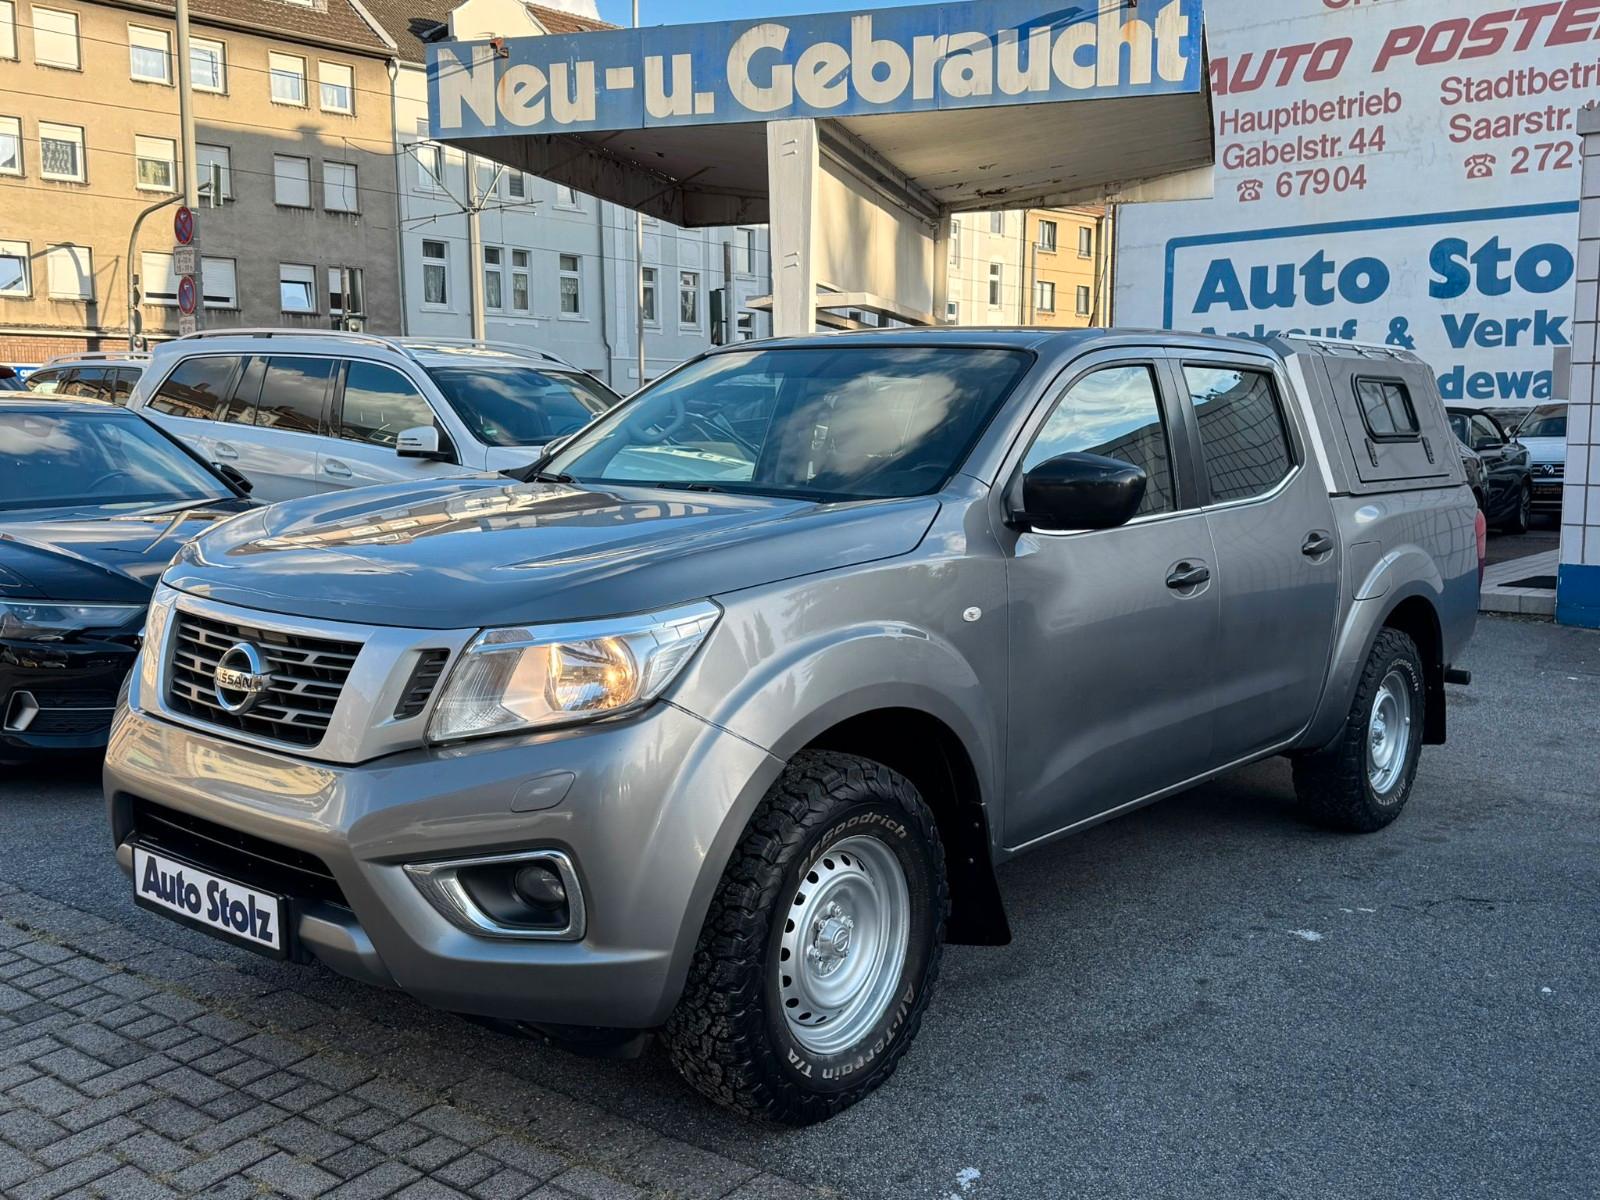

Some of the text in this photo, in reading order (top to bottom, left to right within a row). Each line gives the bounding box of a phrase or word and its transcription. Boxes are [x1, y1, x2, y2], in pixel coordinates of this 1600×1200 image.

[726, 0, 1188, 113] Gebraucht
[1209, 0, 1600, 96] AUTO POSTE
[1219, 87, 1402, 136] Hauptbetrieb
[1449, 105, 1573, 143] Saarstr.
[1222, 125, 1386, 170] Gabelstr. 44
[1510, 140, 1584, 174] 272
[1276, 164, 1367, 198] 67904
[1192, 235, 1574, 314] Auto Sto
[1384, 316, 1416, 350] &
[1441, 309, 1573, 349] Verk
[142, 855, 273, 943] Auto Stolz
